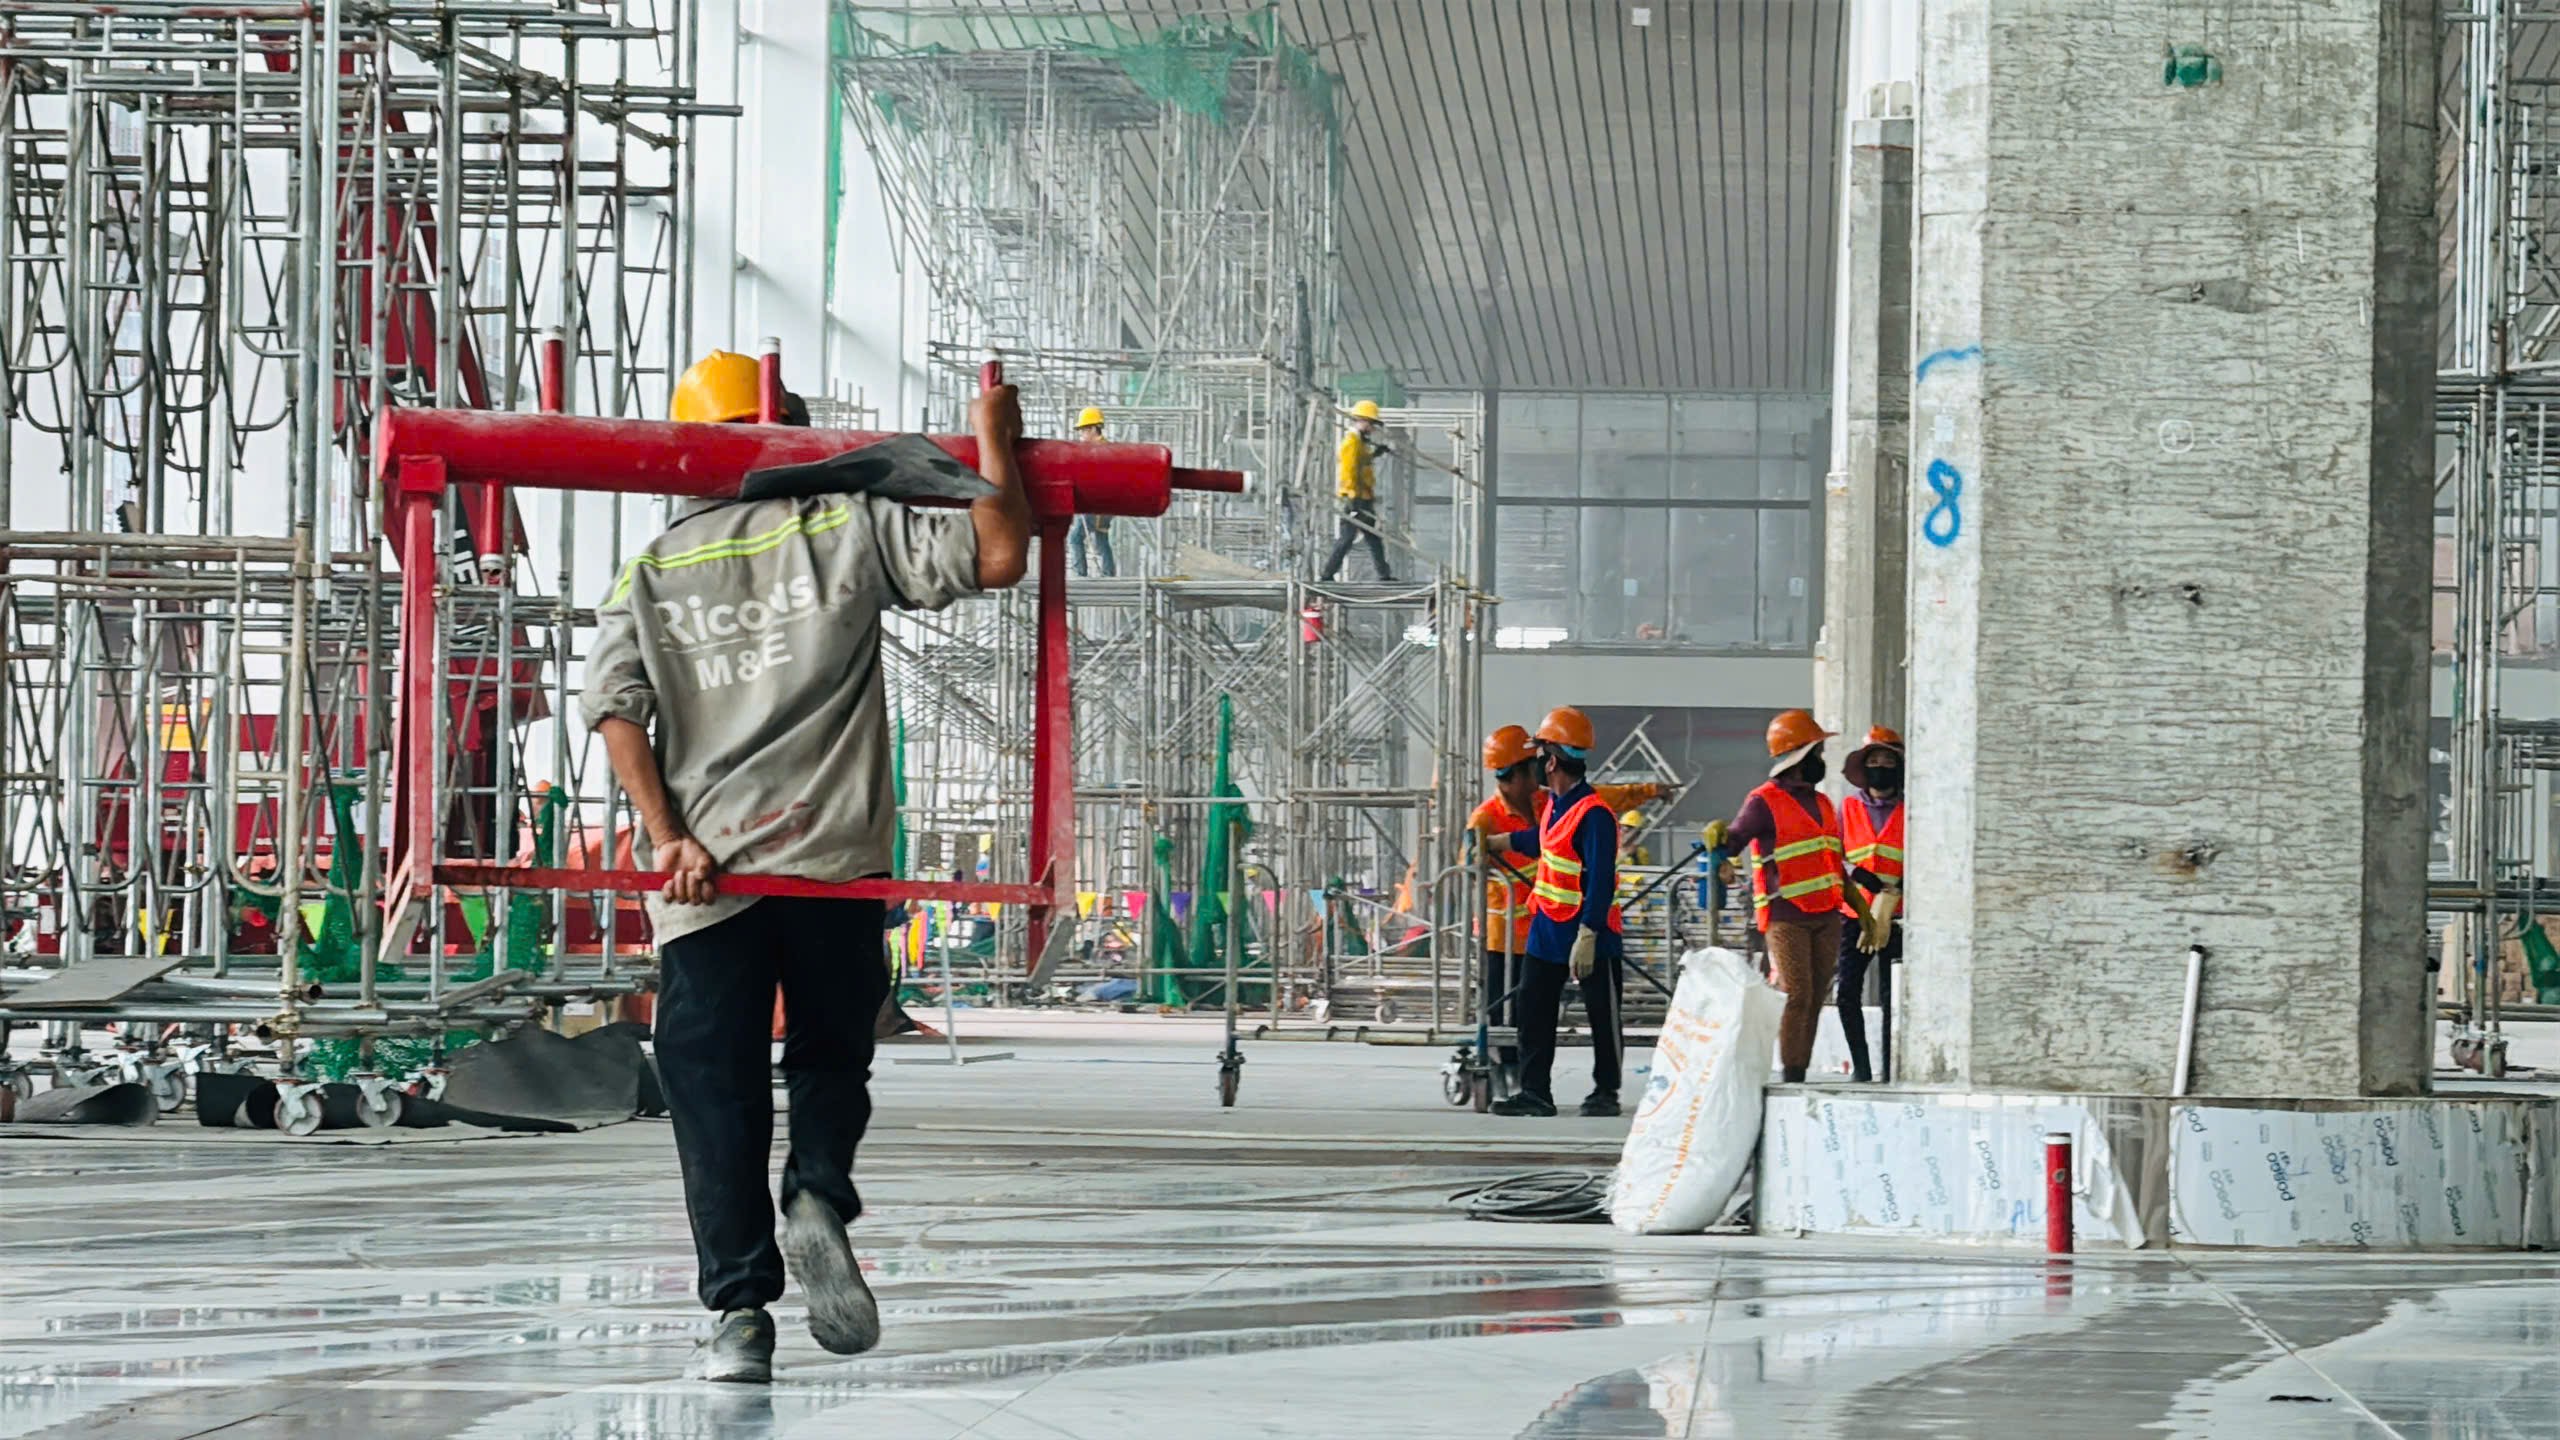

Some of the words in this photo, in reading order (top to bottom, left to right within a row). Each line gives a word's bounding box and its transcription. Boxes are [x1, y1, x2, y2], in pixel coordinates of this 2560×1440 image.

[1923, 458, 1963, 546] 8
[695, 631, 793, 691] M&E
[1975, 1139, 2001, 1190] posco
[2373, 1118, 2399, 1167] posco
[1878, 1171, 1900, 1222] posco
[2209, 1170, 2239, 1220] posco
[2266, 1152, 2296, 1201] posco
